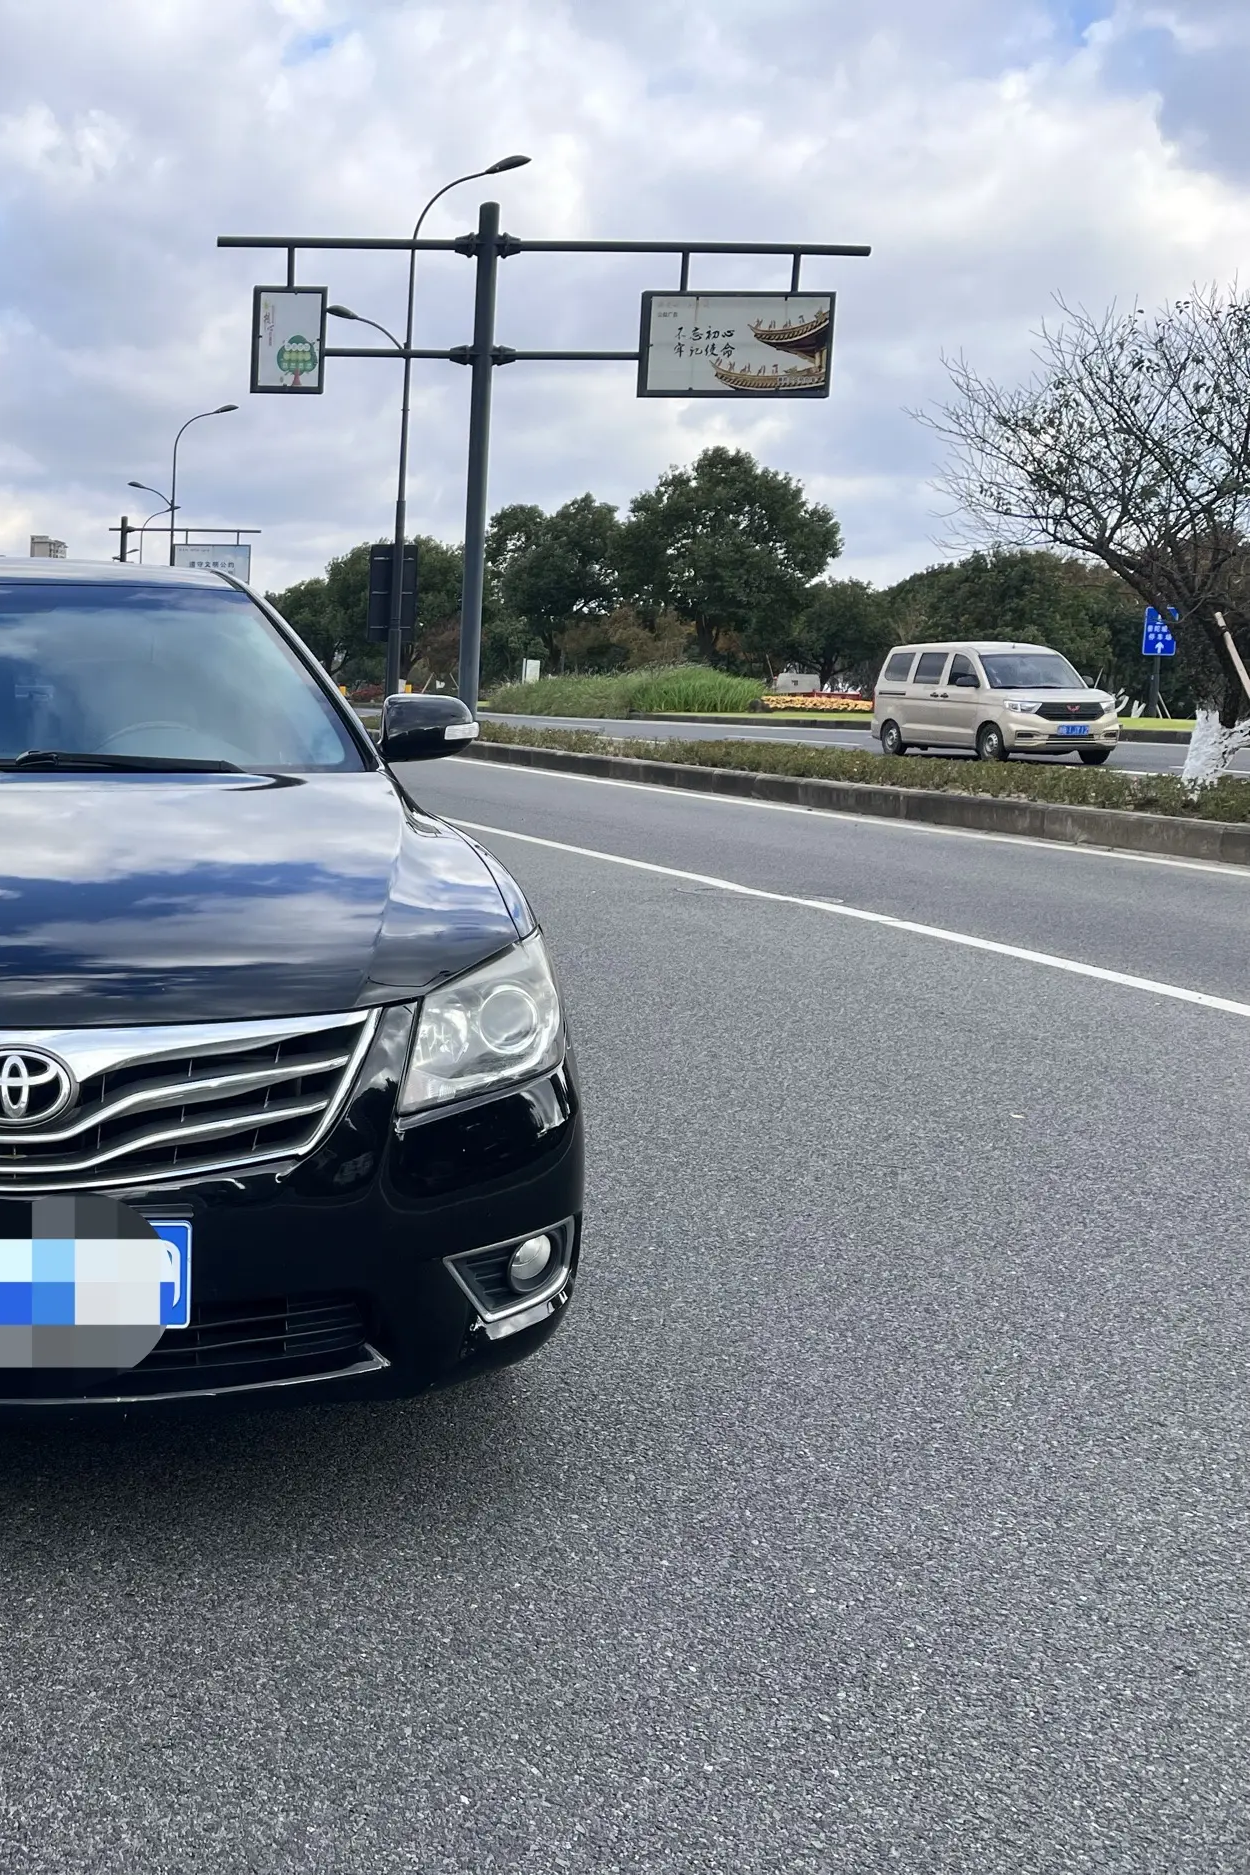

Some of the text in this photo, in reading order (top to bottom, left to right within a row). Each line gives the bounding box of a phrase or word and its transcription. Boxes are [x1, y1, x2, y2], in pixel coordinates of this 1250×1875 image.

[674, 325, 735, 341] 不忘初心
[673, 341, 735, 358] 牢记使命
